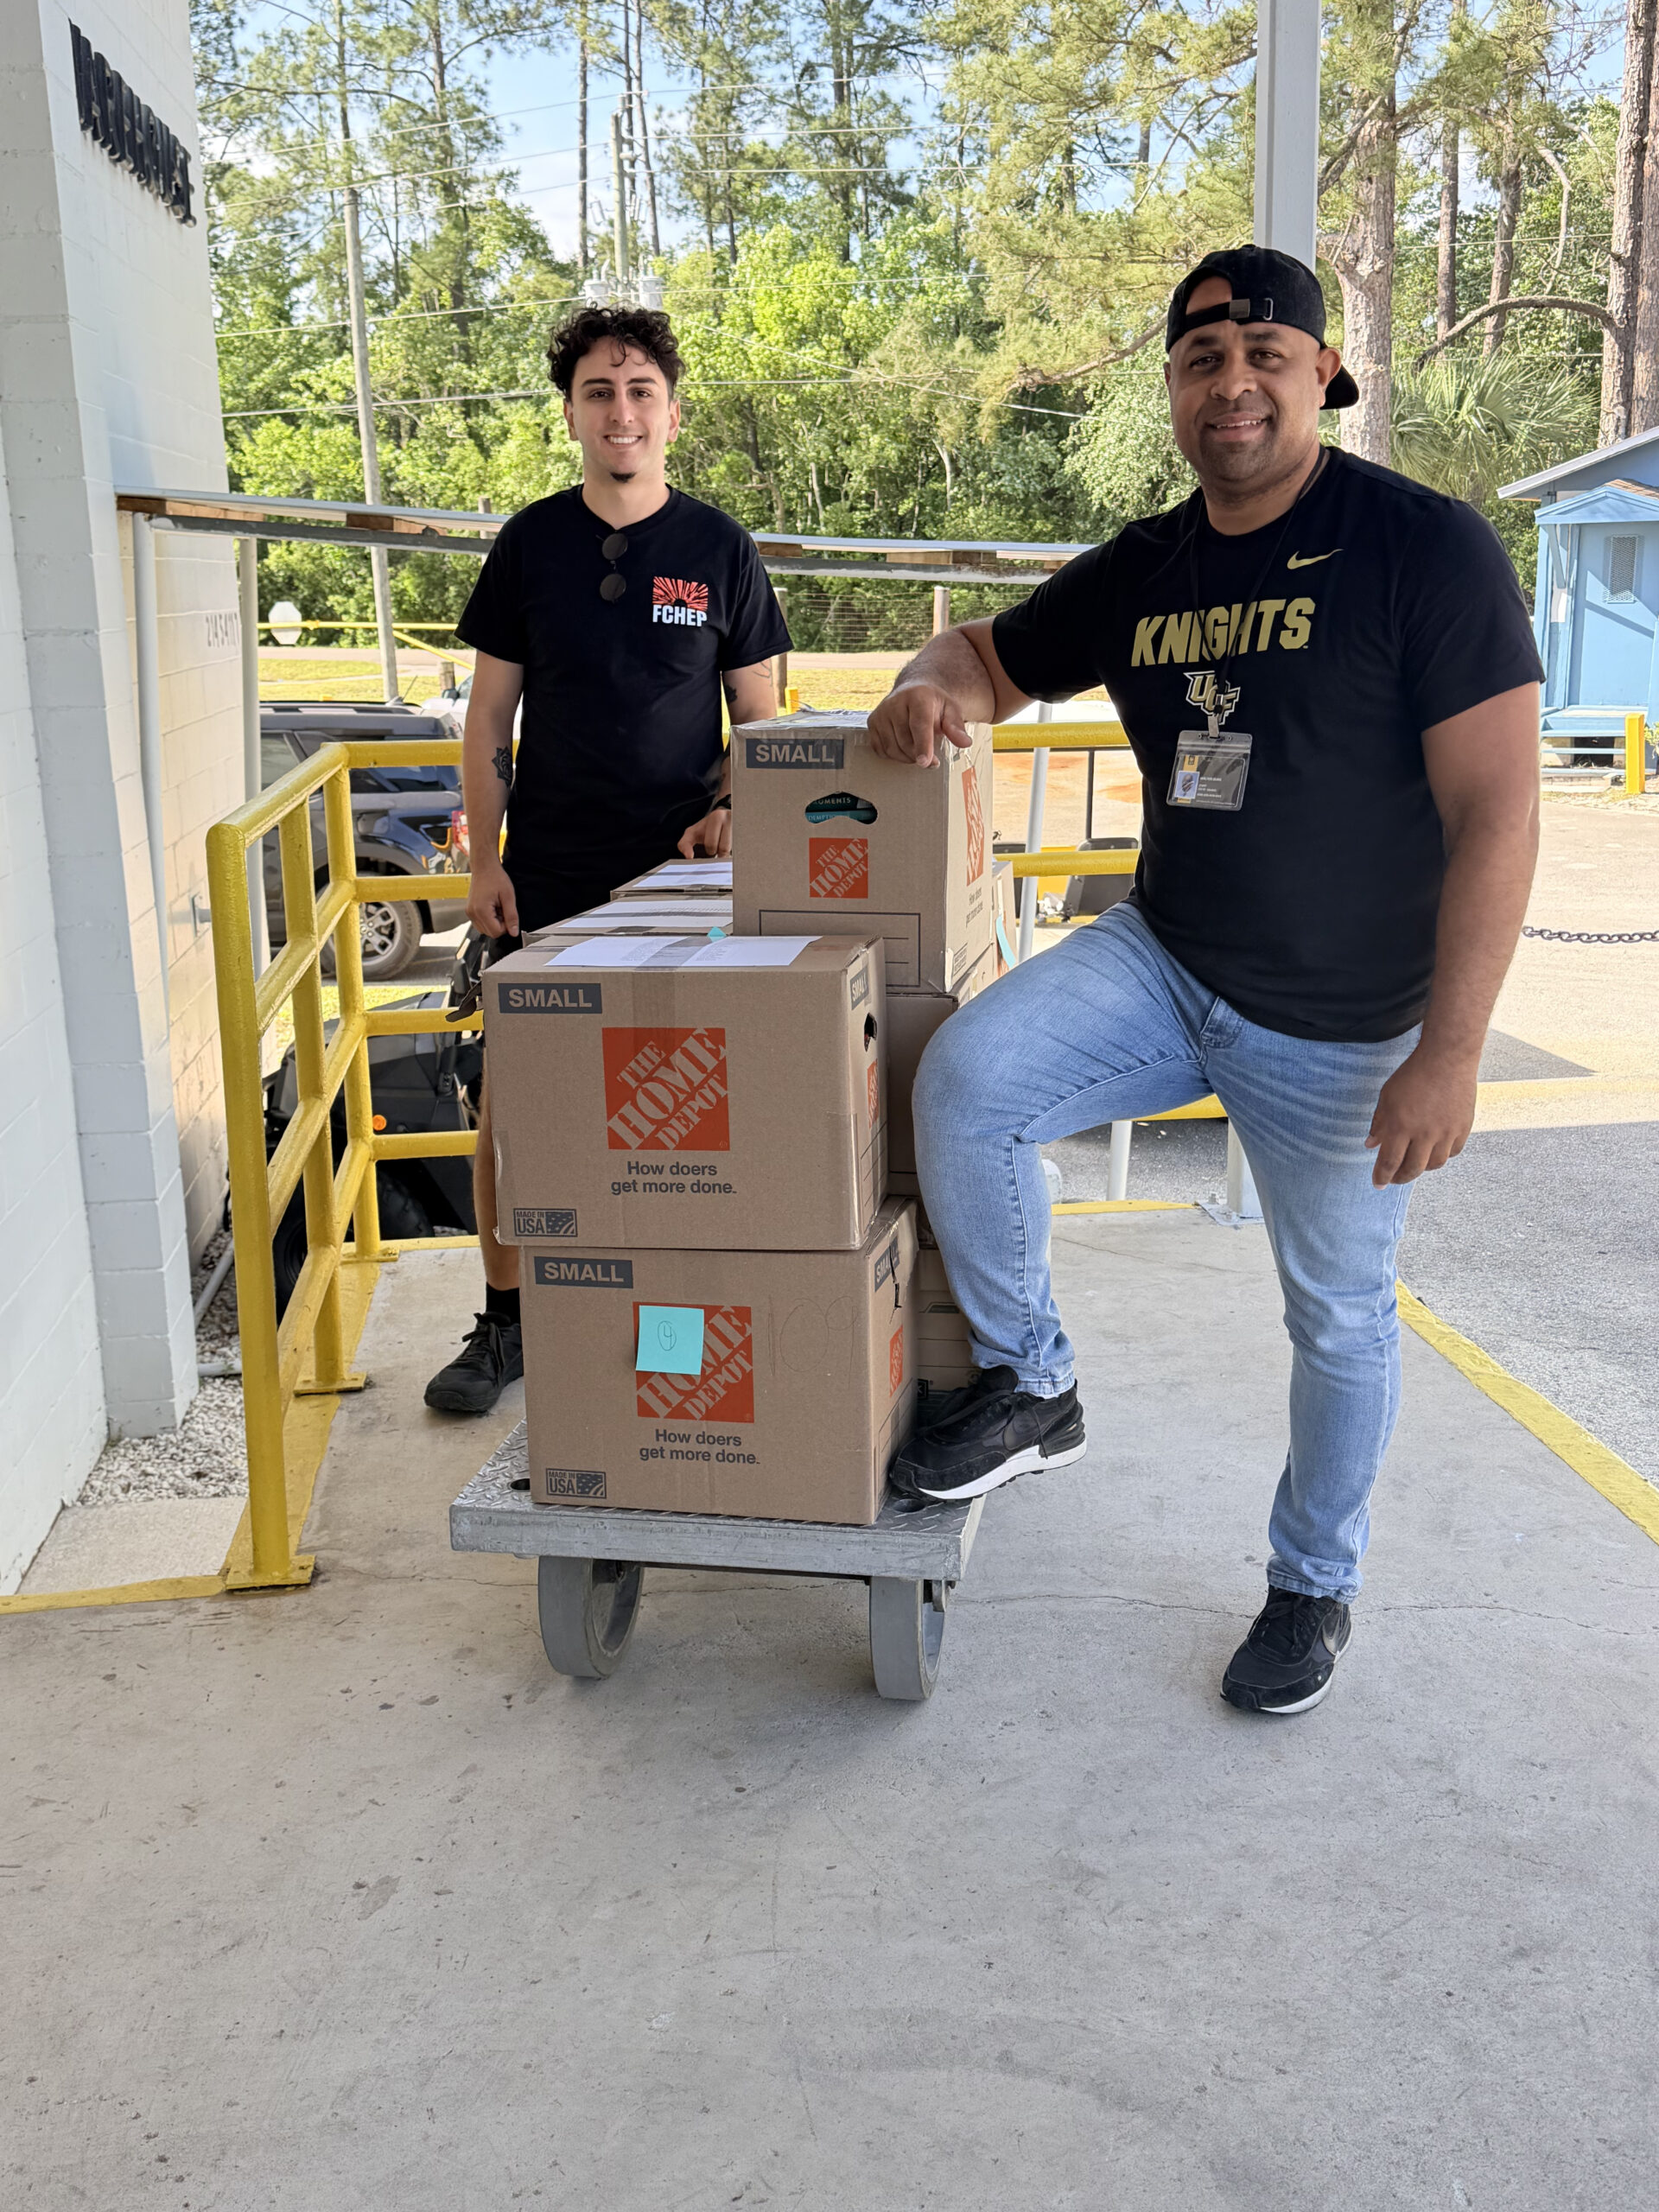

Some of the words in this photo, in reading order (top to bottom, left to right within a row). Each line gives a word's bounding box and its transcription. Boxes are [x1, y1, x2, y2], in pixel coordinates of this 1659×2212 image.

[652, 604, 708, 627] FCHEP
[1131, 597, 1316, 667] KNIGHTS
[755, 744, 836, 763] SMALL
[816, 844, 839, 868] THE
[810, 838, 869, 898] HOME
[833, 861, 869, 898] DEPOT
[508, 988, 593, 1007] SMALL
[616, 1040, 667, 1090] THE
[607, 1027, 728, 1150] HOME
[655, 1073, 728, 1150] DEPOT
[627, 1161, 664, 1175] How
[669, 1161, 718, 1176] doers
[611, 1179, 639, 1196] get
[643, 1181, 686, 1193] more
[518, 1218, 545, 1234] USA
[544, 1262, 625, 1282] SMALL
[683, 1350, 753, 1421] DEPOT
[655, 1428, 691, 1443] How
[696, 1431, 742, 1446] doers
[639, 1446, 665, 1461] get
[670, 1448, 711, 1461] more
[549, 1478, 575, 1494] USA
